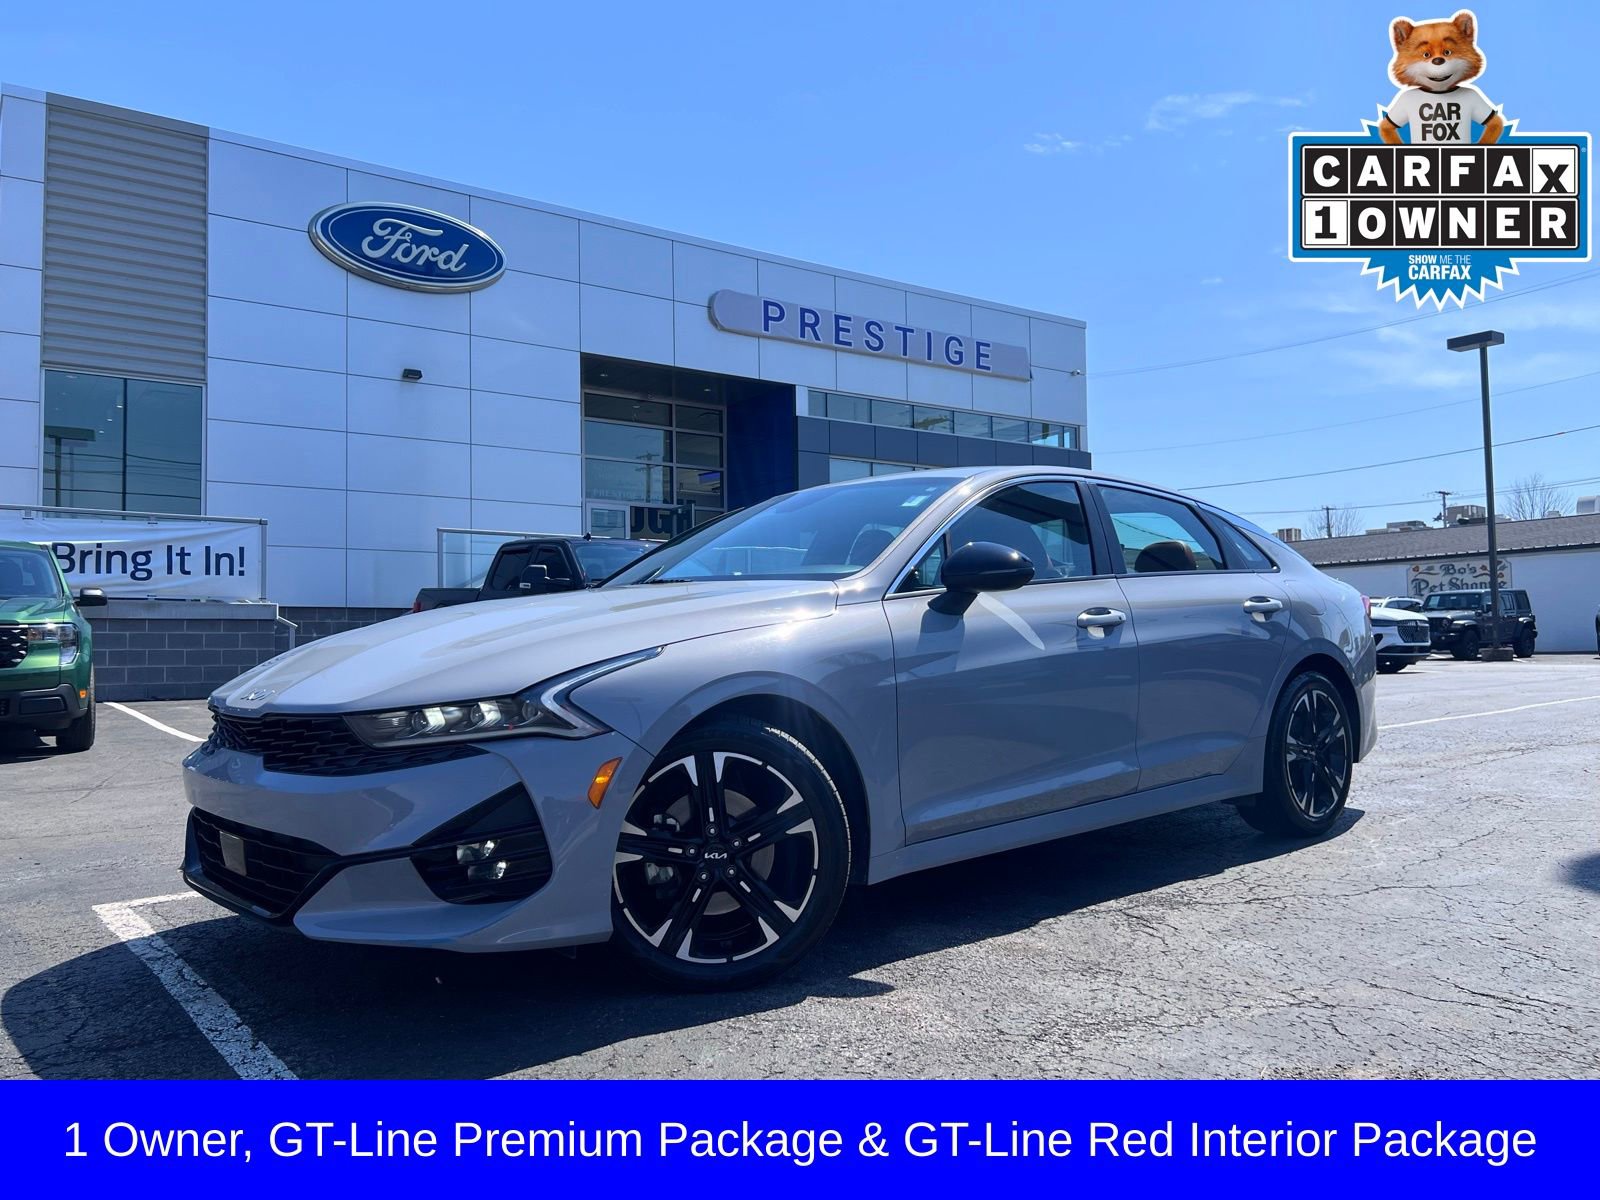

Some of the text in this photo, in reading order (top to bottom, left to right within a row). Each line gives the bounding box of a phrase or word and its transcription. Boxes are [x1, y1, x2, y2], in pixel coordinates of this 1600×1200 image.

[361, 217, 470, 272] Ford
[762, 298, 992, 372] PRESTIGE
[51, 542, 246, 582] Bring It In!
[1440, 563, 1478, 577] Bo's
[1411, 576, 1508, 597] Pet Shope
